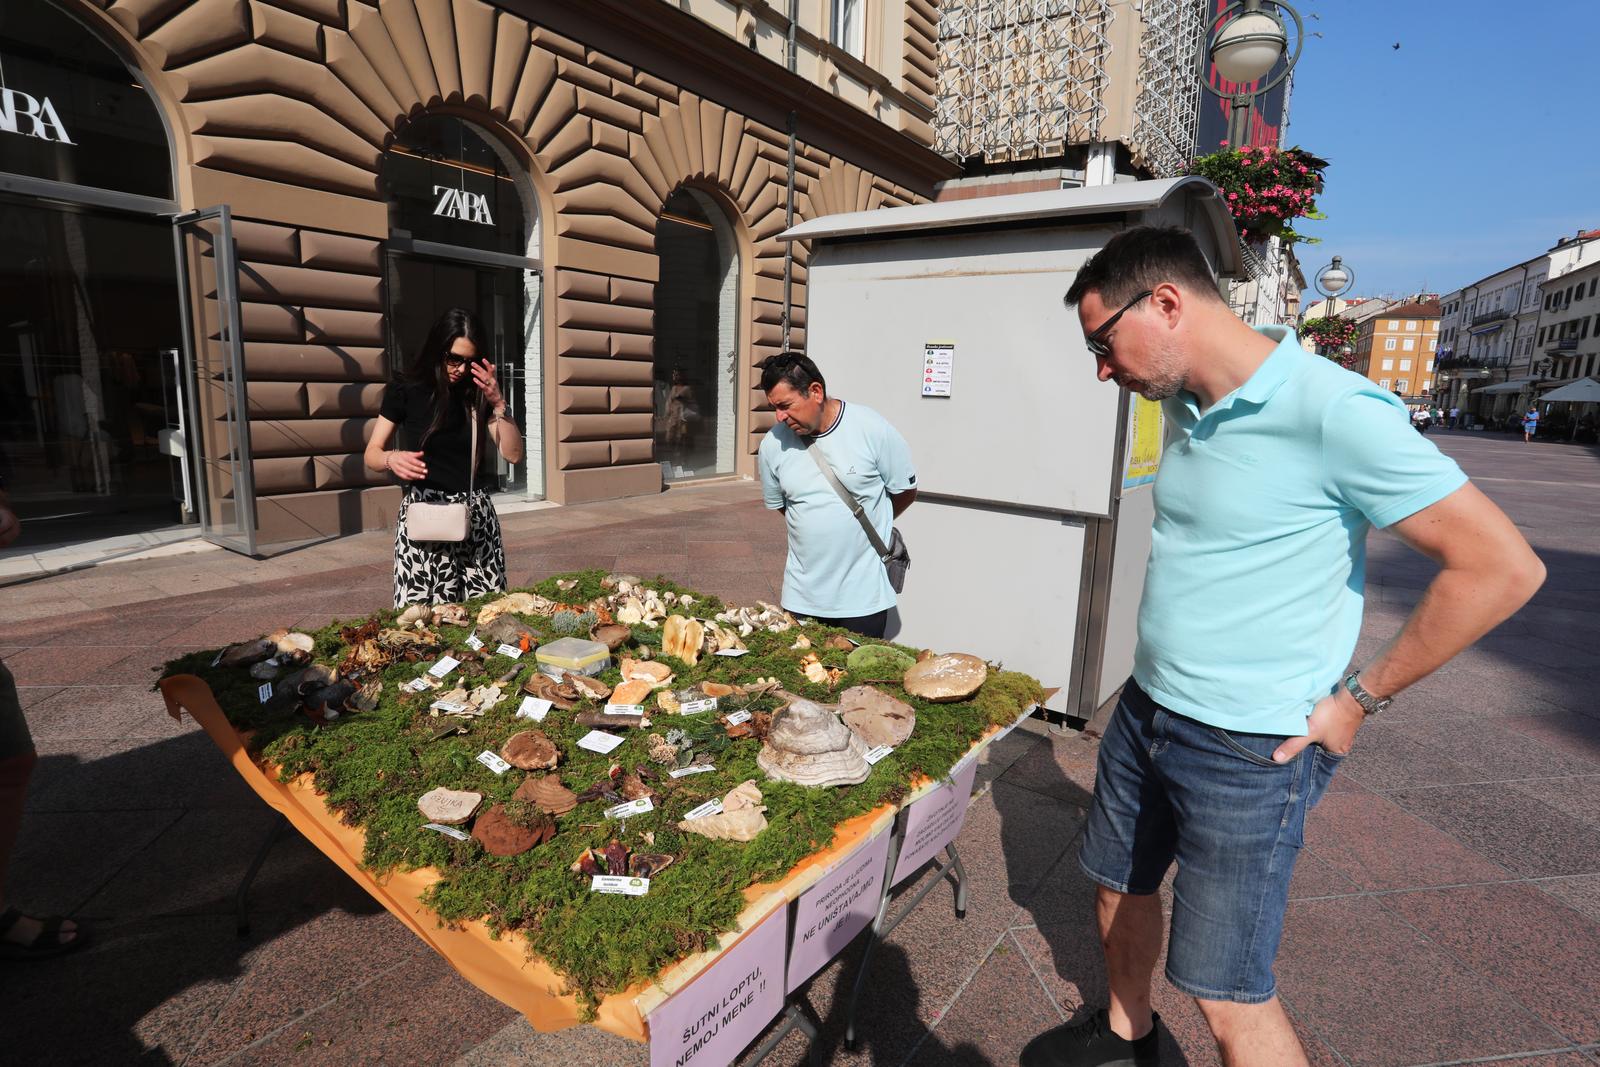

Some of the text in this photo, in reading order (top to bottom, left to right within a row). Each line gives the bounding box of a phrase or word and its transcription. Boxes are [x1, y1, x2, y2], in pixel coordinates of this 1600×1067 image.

[432, 185, 496, 226] ZARA
[803, 876, 874, 943] NE UNIŠTAVAJMO
[816, 883, 842, 908] PRIRODA
[675, 1023, 719, 1067] NEMOJ
[722, 991, 754, 1028] MENE
[683, 967, 762, 1044] ŠUTNI LOPTU,
